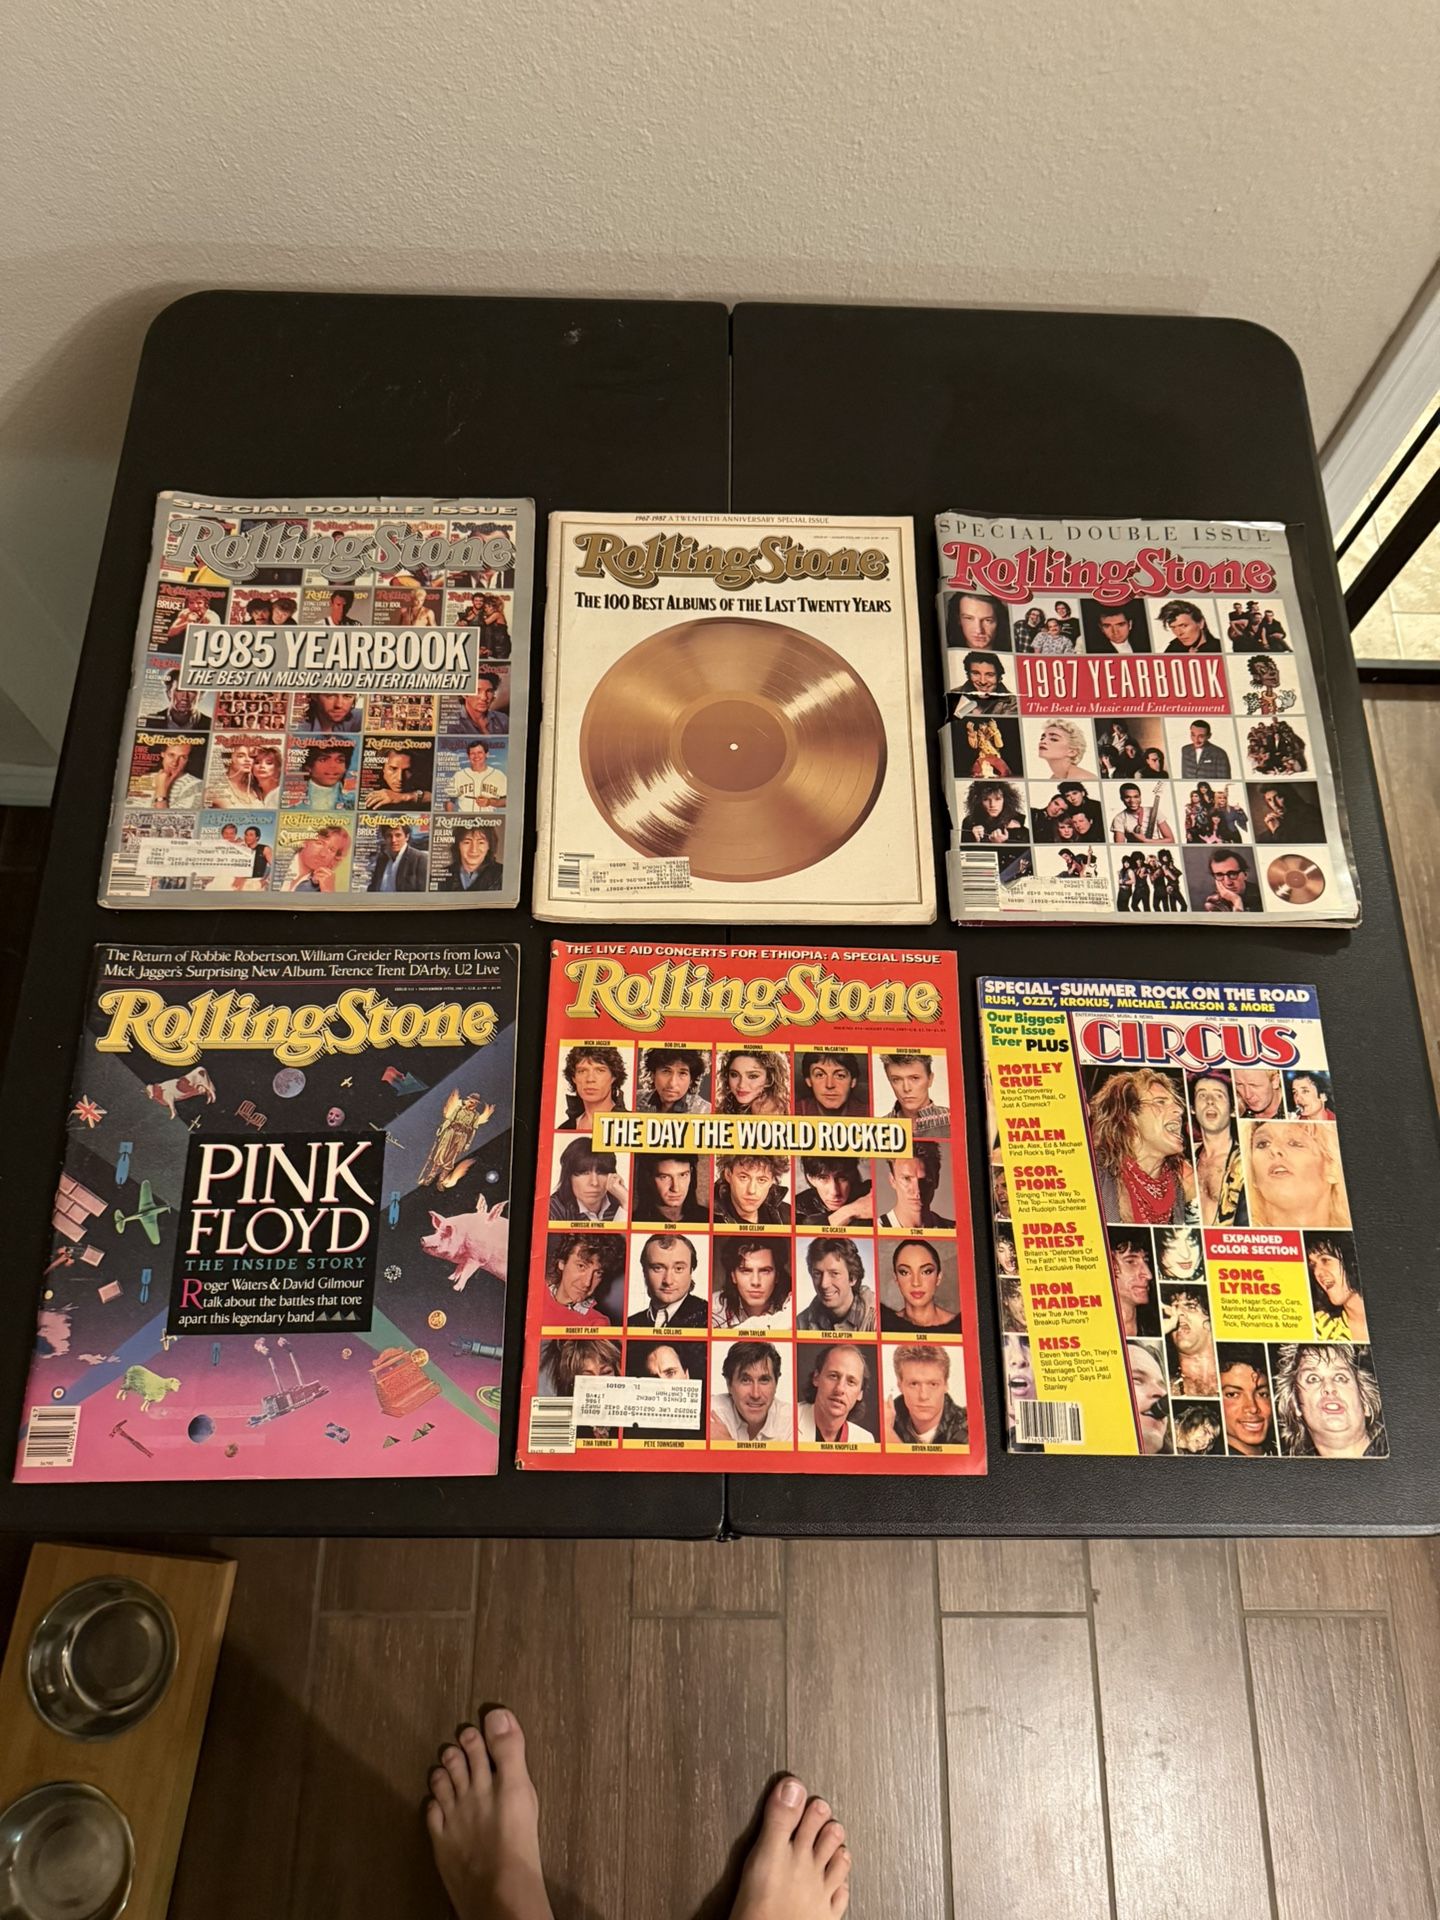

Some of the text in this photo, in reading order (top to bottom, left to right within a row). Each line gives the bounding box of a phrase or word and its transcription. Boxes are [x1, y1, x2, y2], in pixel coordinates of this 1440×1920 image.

[172, 498, 517, 516] SPECIAL DOUBLE ISSUE
[635, 515, 667, 523] 1967-1987
[668, 515, 674, 523] A
[674, 515, 720, 523] TWENTIETH
[722, 516, 775, 524] ANNIVERSARY
[776, 516, 807, 524] SPECIAL
[938, 519, 1271, 543] SPECIAL DOUBLE ISSUE
[188, 629, 471, 671] 1985 YEARBOOK
[186, 668, 470, 690] THE BEST IN MUSIC AND ENTERTAINMENT
[1022, 658, 1227, 700] 1987 YEARBOOK
[1026, 702, 1226, 714] The Best in Music and Entertainment
[433, 836, 456, 844] LENNON
[106, 948, 501, 963] The Return of Robbie Robertson. William Greider Reports from Iowa
[566, 944, 941, 964] THE LIVE AID CONCERTS FOR ETHIOPIA: A SPECIAL ISSUE
[104, 963, 135, 977] Mick
[137, 965, 183, 980] Jagger's
[185, 965, 249, 980] Surprising
[251, 965, 280, 977] New
[281, 964, 327, 977] Album.
[328, 964, 374, 976] Terence
[375, 964, 406, 976] Trent
[454, 964, 472, 975] U2
[476, 963, 500, 975] Live
[1140, 984, 1190, 1000] ROCK
[1192, 986, 1220, 1001] ON
[1223, 987, 1256, 1002] THE
[1259, 988, 1310, 1003] ROAD
[985, 995, 1276, 1013] RUSH, OZZY, KROKUS, MICHAEL JACKSON & MORE
[987, 1011, 1066, 1026] Our Biggest
[989, 1023, 1055, 1035] Tour Issue
[991, 1035, 1069, 1052] Ever PLUS
[1081, 1018, 1301, 1072] CIRCUS
[997, 1062, 1063, 1075] MOTLEY
[999, 1076, 1043, 1088] CRUE
[1005, 1117, 1041, 1129] VAN
[600, 1117, 907, 1153] THE DAY THE WORLD ROCKED
[1007, 1129, 1066, 1142] HALEN
[192, 1140, 375, 1206] PINK
[1013, 1165, 1063, 1178] SCOR-
[1015, 1177, 1067, 1191] PIONS
[185, 1207, 370, 1256] FLOYD
[1022, 1221, 1077, 1235] JUDAS
[1023, 1235, 1085, 1249] PRIEST
[1222, 1233, 1283, 1244] EXPANDED
[1210, 1244, 1299, 1256] COLOR SECTION
[185, 1256, 367, 1272] THE INSIDE STORY
[1218, 1268, 1265, 1281] SONG
[232, 1278, 268, 1291] Waters
[269, 1278, 281, 1290] &
[282, 1277, 315, 1290] David
[317, 1276, 365, 1290] Gilmour
[1030, 1282, 1074, 1296] IRON
[1219, 1282, 1282, 1296] LYRICS
[203, 1293, 363, 1308] talk about the battles that tore
[1031, 1294, 1103, 1311] MAIDEN
[178, 1311, 315, 1328] apart this legendary band
[1033, 1311, 1047, 1319] How
[1048, 1310, 1062, 1318] True
[1076, 1309, 1088, 1317] The
[663, 1328, 682, 1336] COLLINS
[1038, 1336, 1081, 1350] KISS
